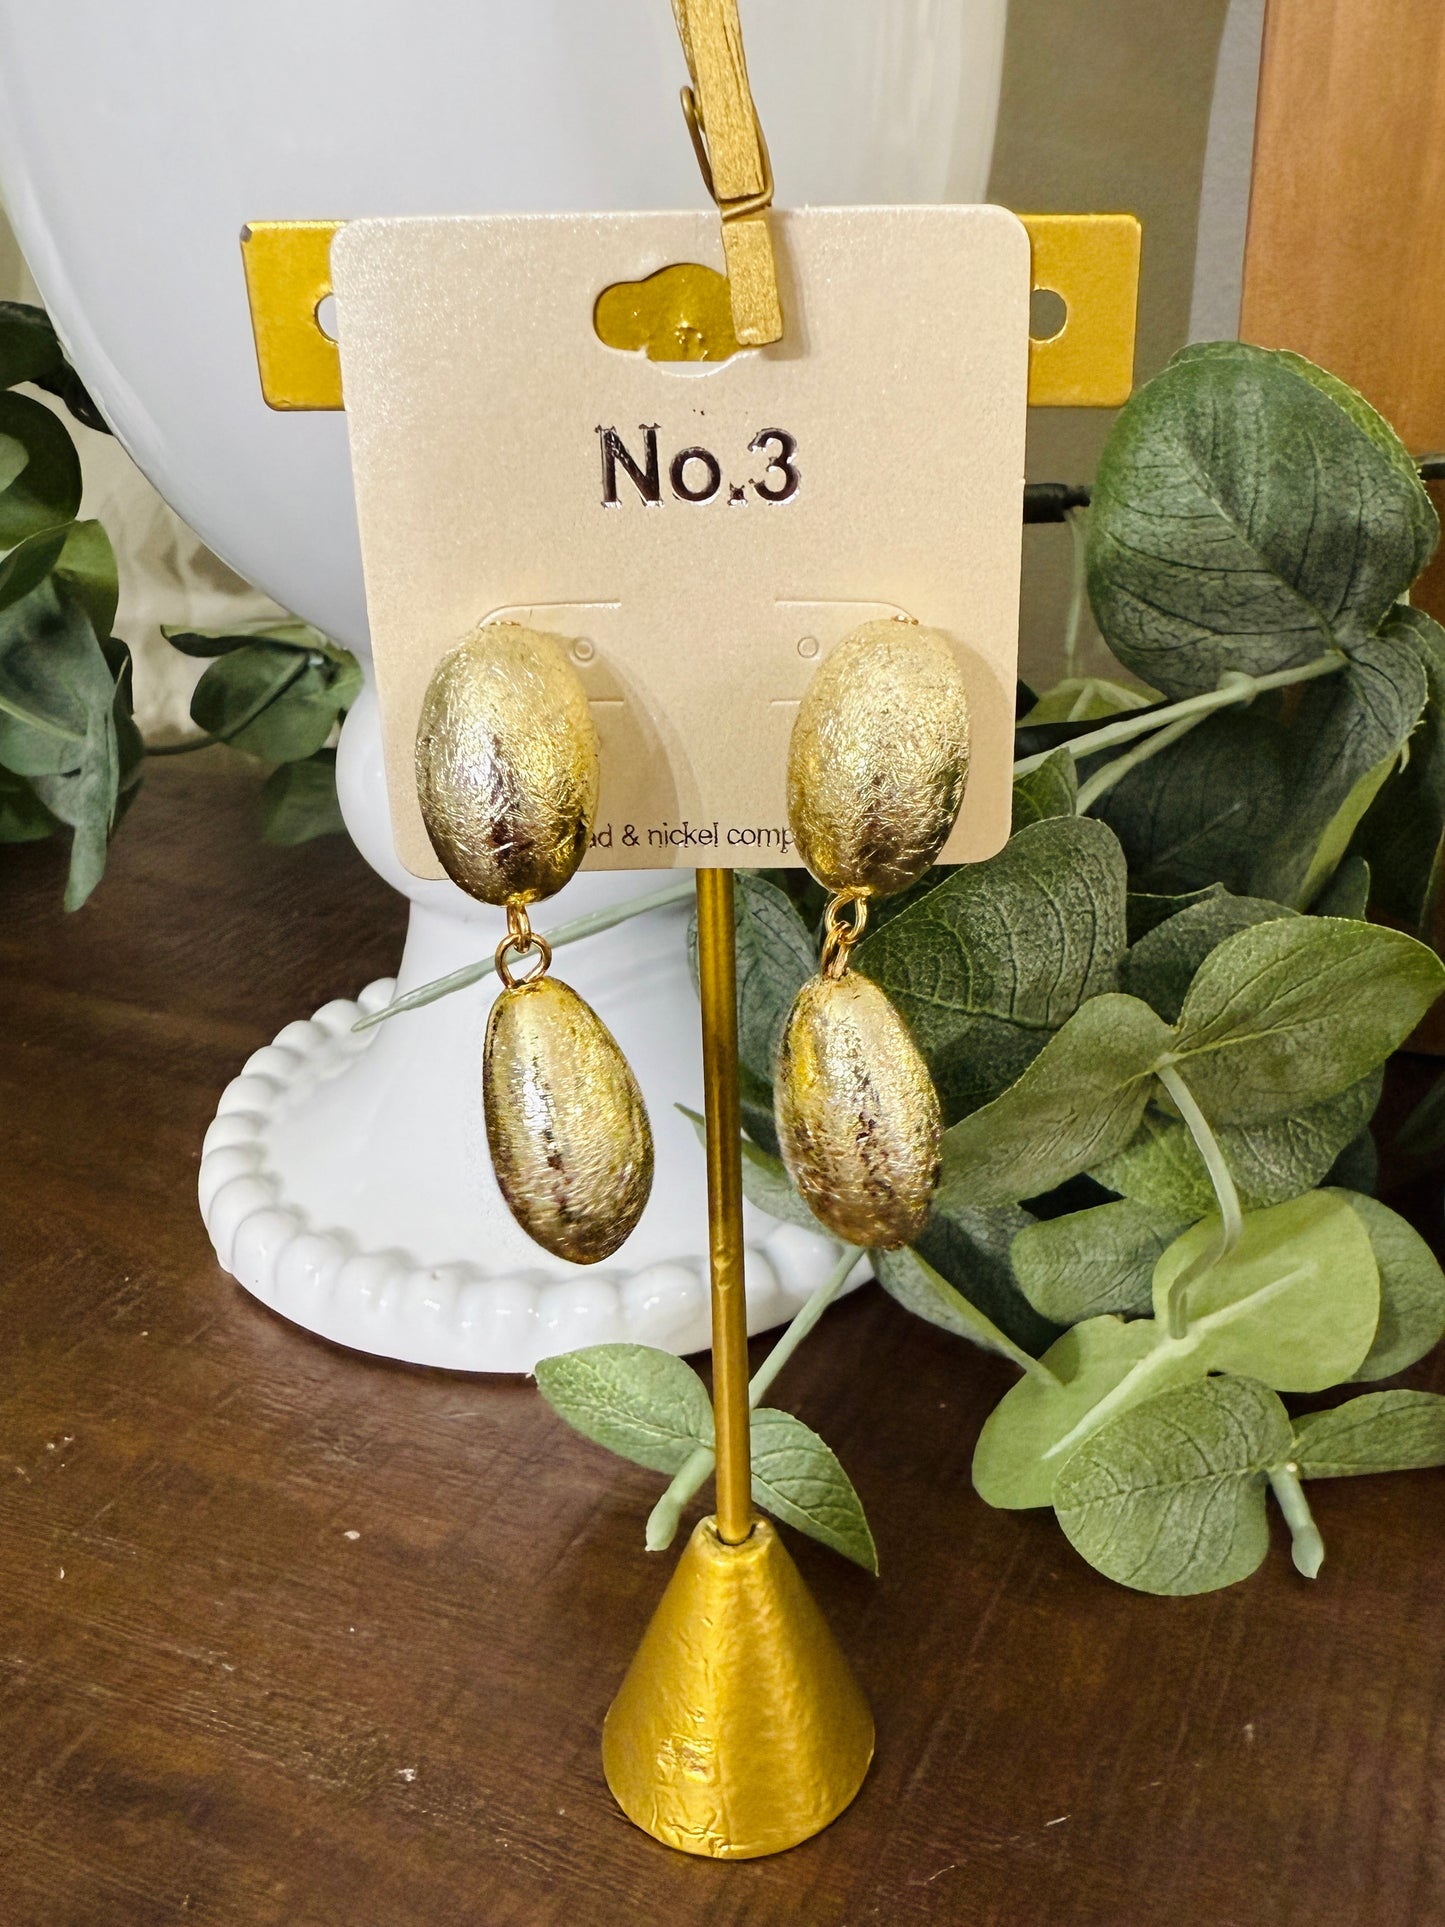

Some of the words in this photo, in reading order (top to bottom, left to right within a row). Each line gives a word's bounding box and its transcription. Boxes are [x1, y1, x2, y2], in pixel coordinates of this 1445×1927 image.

[595, 423, 800, 507] No.3
[622, 824, 640, 847] &
[648, 821, 719, 848] nickel
